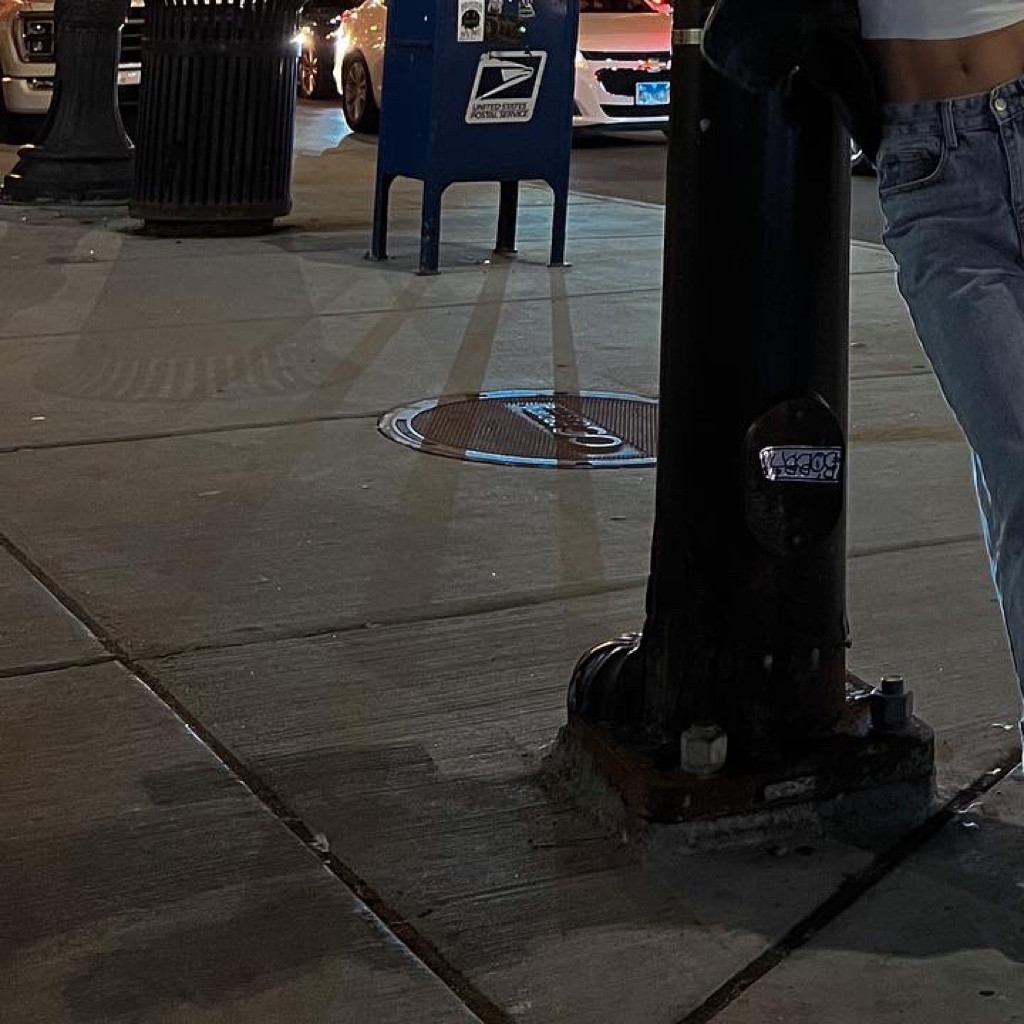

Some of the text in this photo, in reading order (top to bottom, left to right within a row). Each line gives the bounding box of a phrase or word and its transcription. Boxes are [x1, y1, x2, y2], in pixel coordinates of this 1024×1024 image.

[472, 102, 527, 112] UNITED STATES
[471, 110, 498, 119] POSTAL
